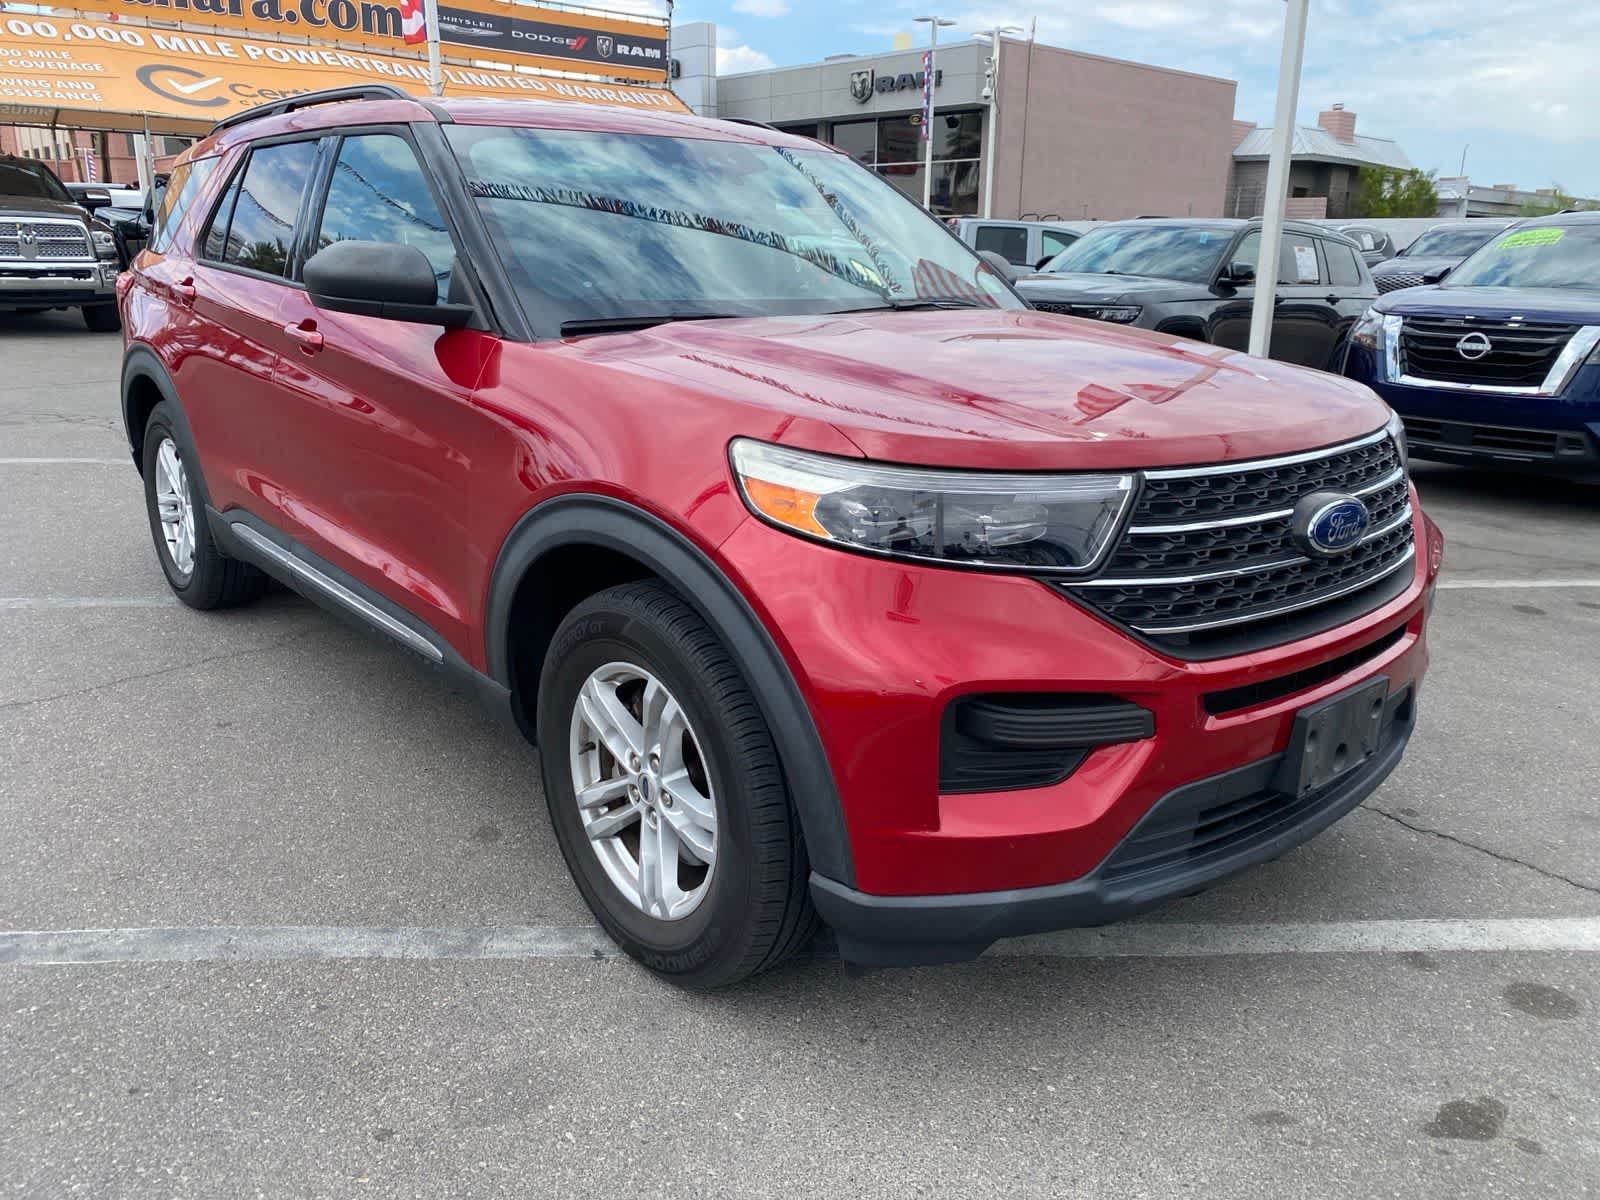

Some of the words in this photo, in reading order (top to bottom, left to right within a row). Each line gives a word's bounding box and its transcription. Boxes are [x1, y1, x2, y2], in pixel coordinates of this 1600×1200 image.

[511, 30, 577, 46] DODGE
[617, 44, 661, 59] RAM
[8, 59, 105, 72] COVERAGE
[151, 34, 240, 59] MILE
[443, 69, 549, 92] LIMITED
[549, 81, 673, 106] WARRANTY
[56, 79, 96, 90] AND
[1328, 510, 1361, 542] Ford
